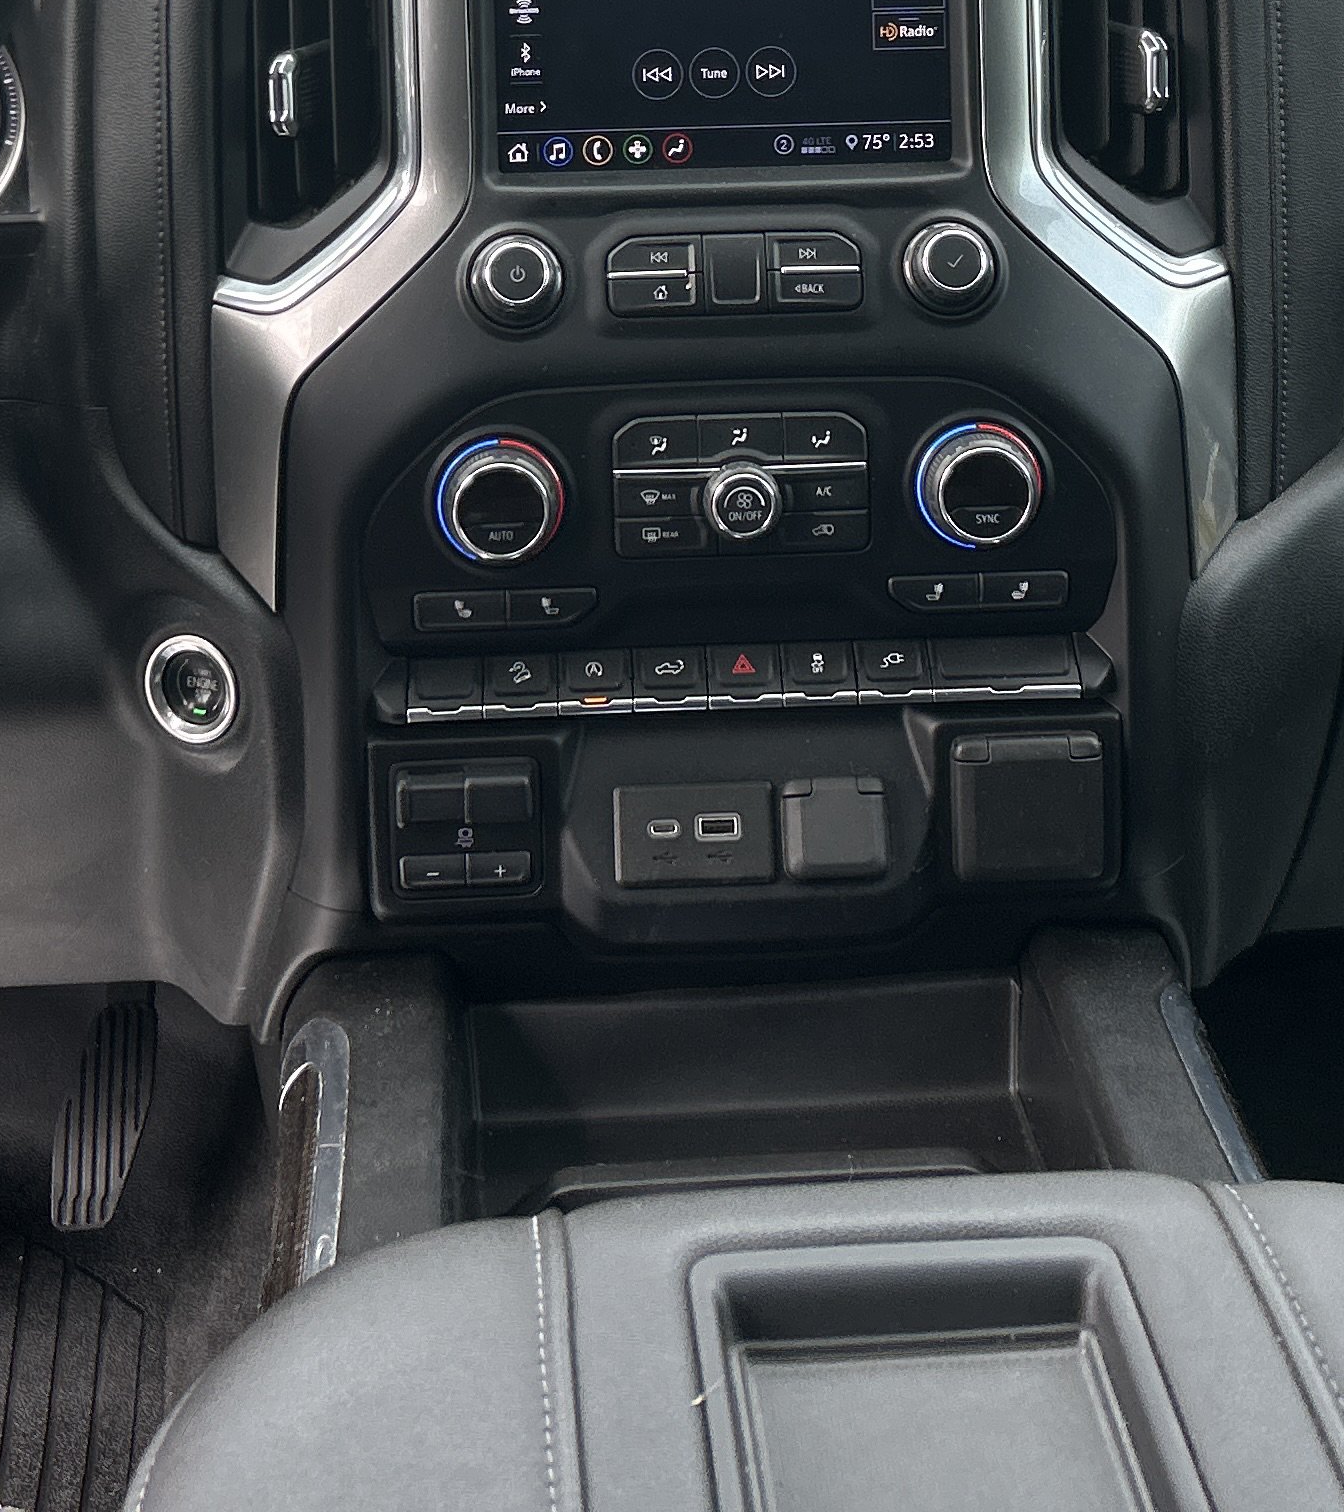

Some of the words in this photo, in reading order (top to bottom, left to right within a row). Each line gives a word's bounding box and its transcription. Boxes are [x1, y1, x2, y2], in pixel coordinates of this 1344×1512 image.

[899, 24, 935, 38] Radio
[700, 67, 728, 80] Tune
[505, 102, 535, 114] More
[898, 133, 934, 149] 2:53
[800, 283, 825, 294] BACK
[815, 486, 833, 497] A/C
[728, 511, 763, 523] ON/OFF
[975, 512, 1001, 526] SYNC
[488, 529, 514, 542] AUTO
